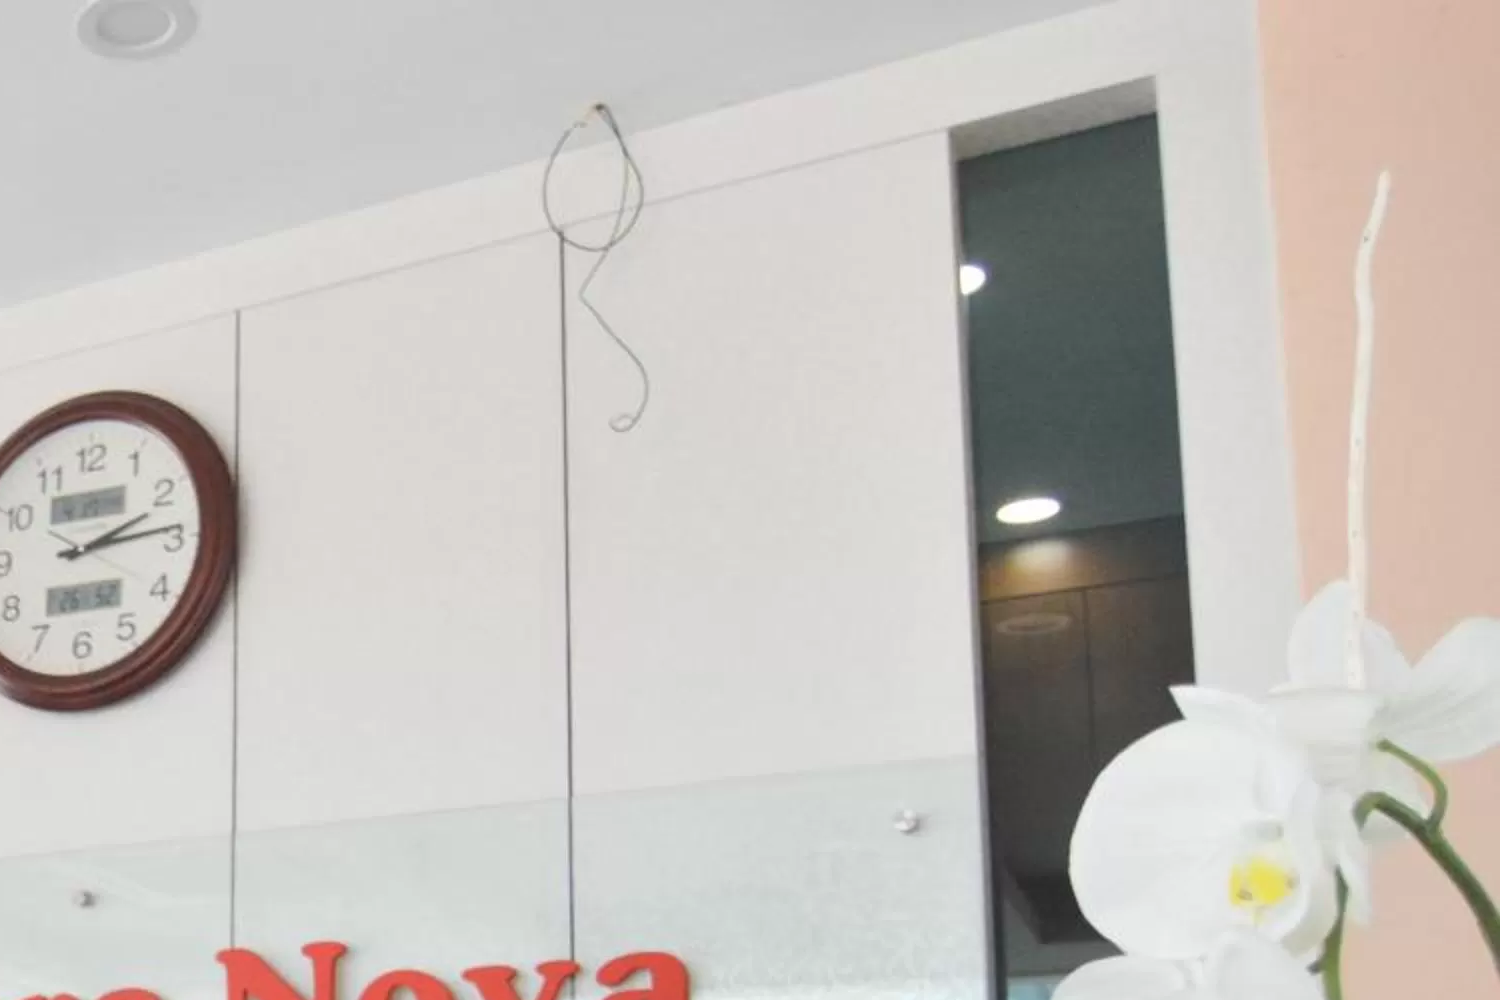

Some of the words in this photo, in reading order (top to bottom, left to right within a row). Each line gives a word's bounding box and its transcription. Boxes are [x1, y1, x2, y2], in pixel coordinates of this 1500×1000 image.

[76, 443, 107, 473] 12
[128, 450, 141, 477] 1
[36, 465, 63, 494] 11
[153, 478, 176, 508] 2
[6, 503, 34, 532] 10
[162, 523, 185, 553] 3
[149, 572, 170, 601] 4
[2, 594, 21, 623] 8
[31, 623, 50, 654] 7
[115, 612, 137, 641] 5
[71, 630, 93, 660] 6
